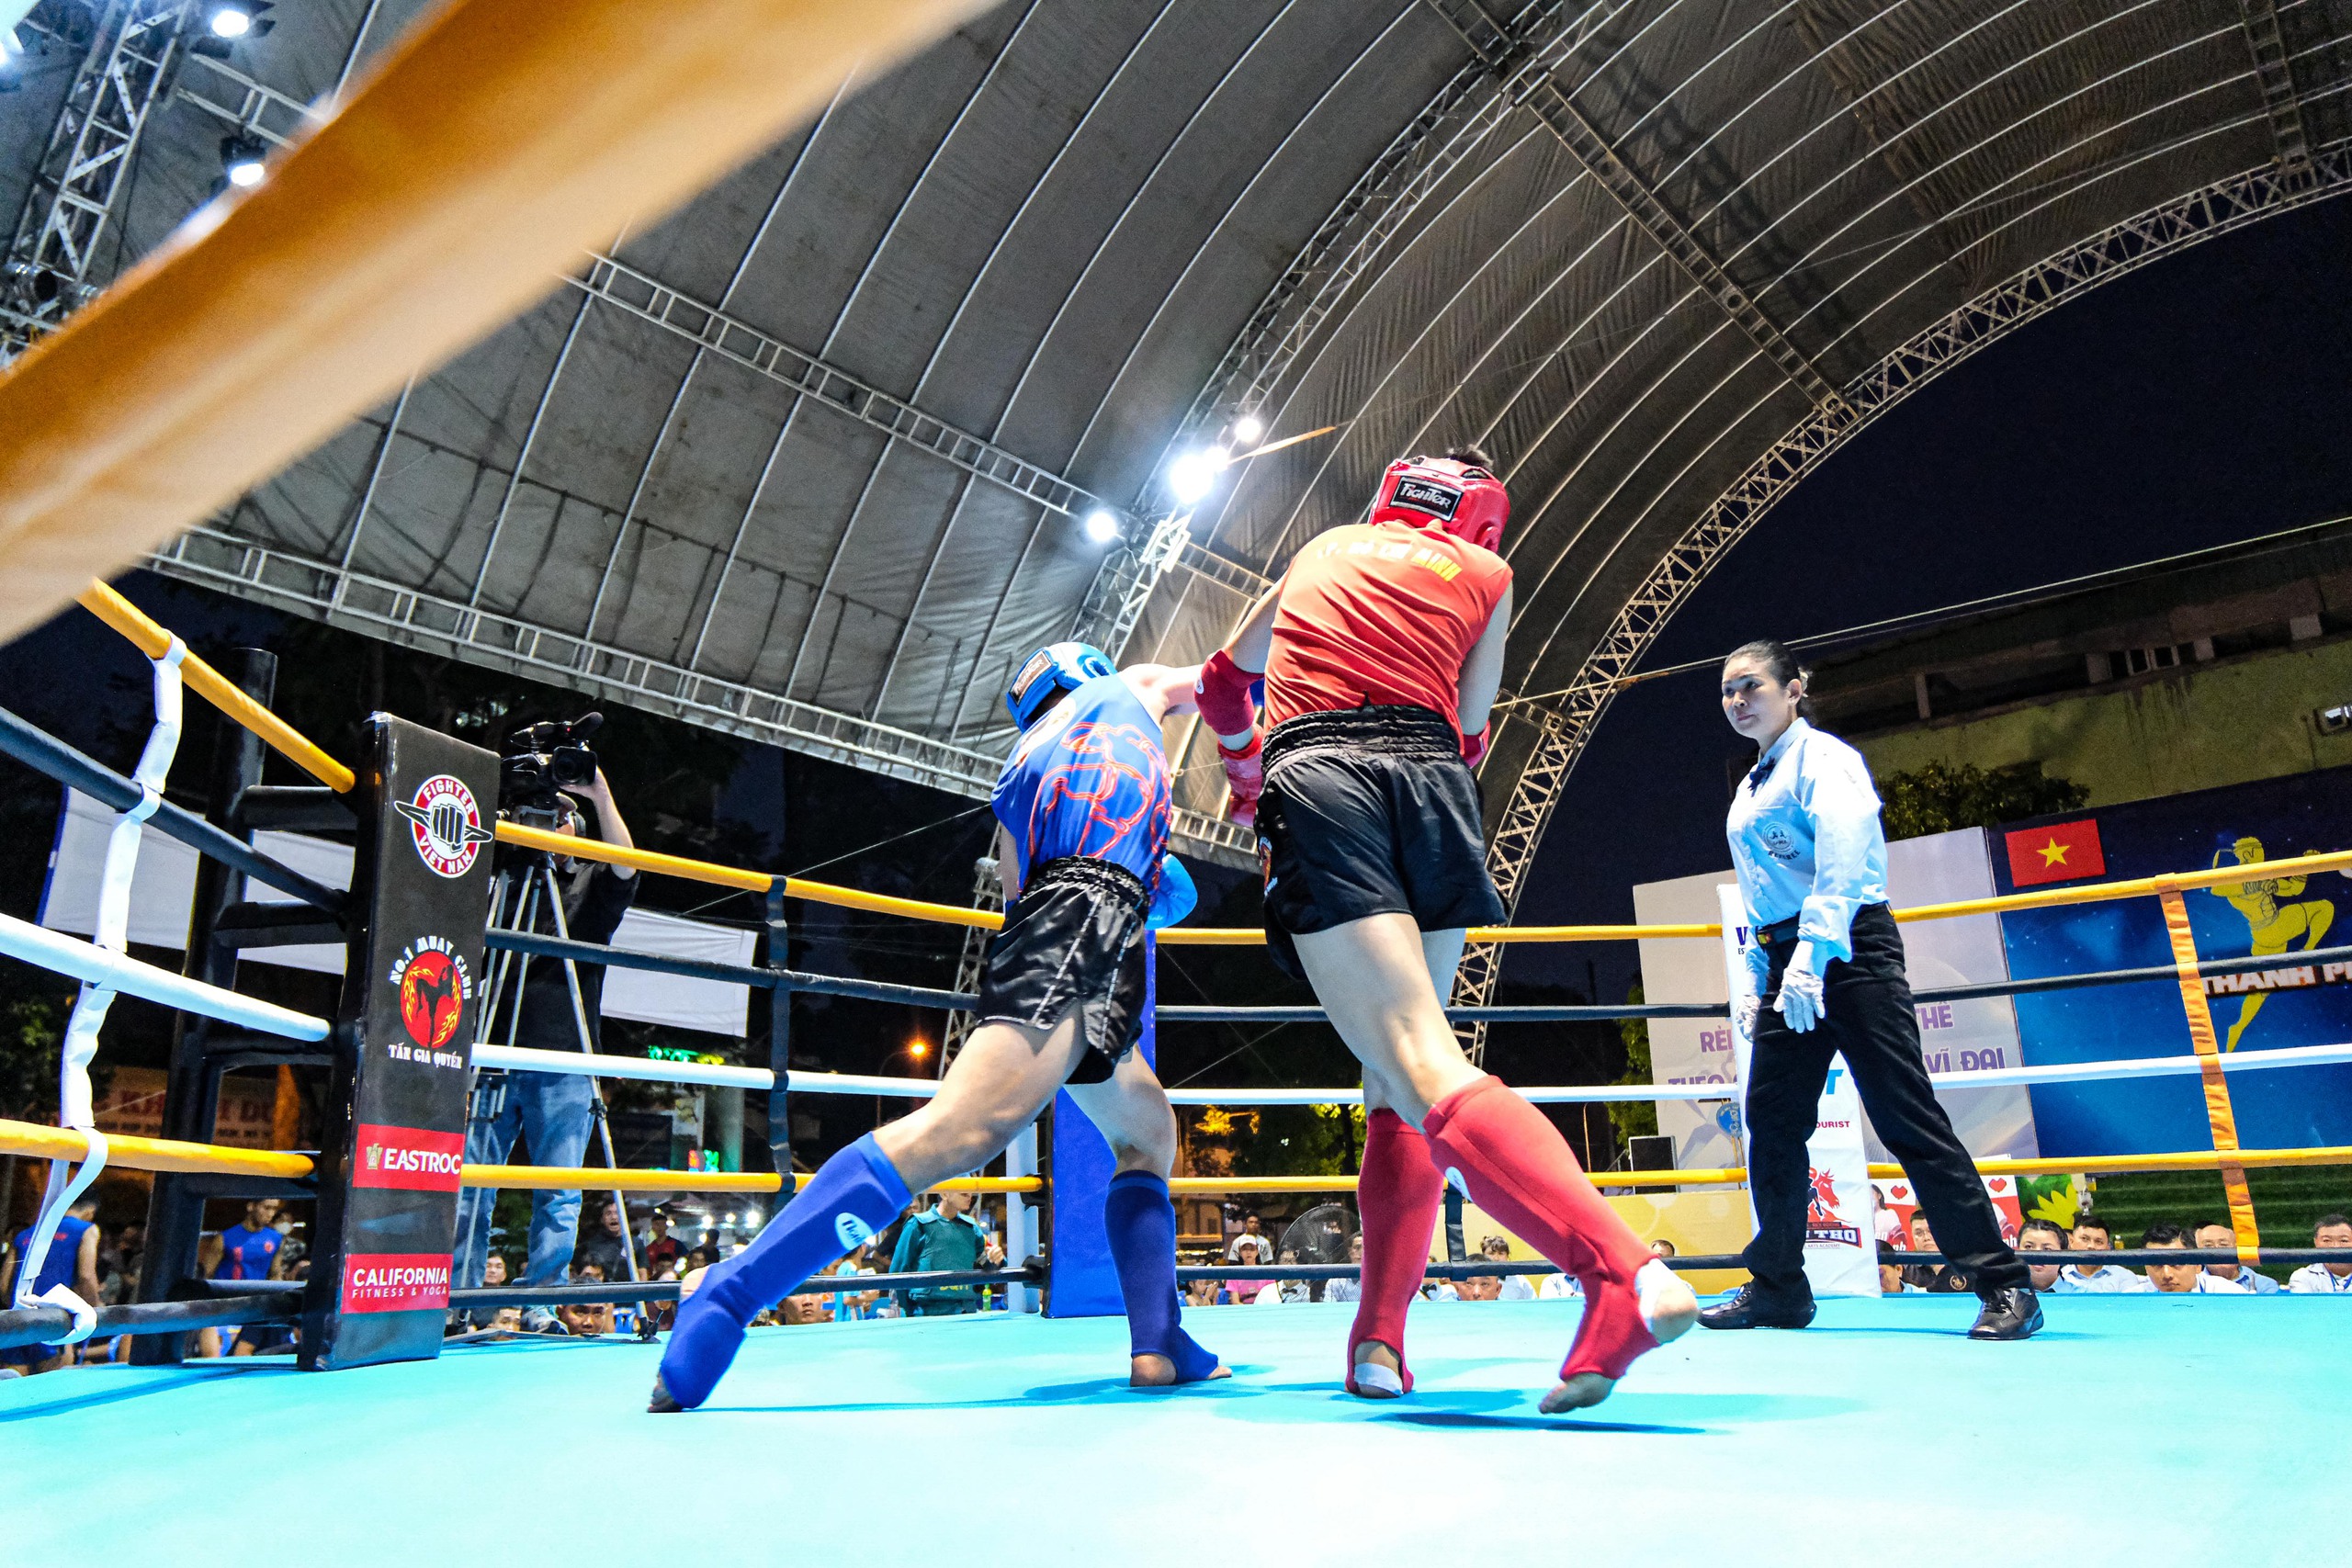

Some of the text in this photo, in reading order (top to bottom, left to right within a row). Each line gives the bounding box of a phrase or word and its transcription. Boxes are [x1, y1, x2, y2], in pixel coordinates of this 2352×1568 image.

[423, 779, 475, 815] FIGHTER
[419, 835, 473, 874] VIET NAM
[389, 935, 472, 1000] NO.1 MUAY CLUB
[384, 1147, 461, 1175] EASTROC
[352, 1286, 447, 1299] FITNESS & YOGA
[353, 1267, 448, 1287] CALIFORNIA
